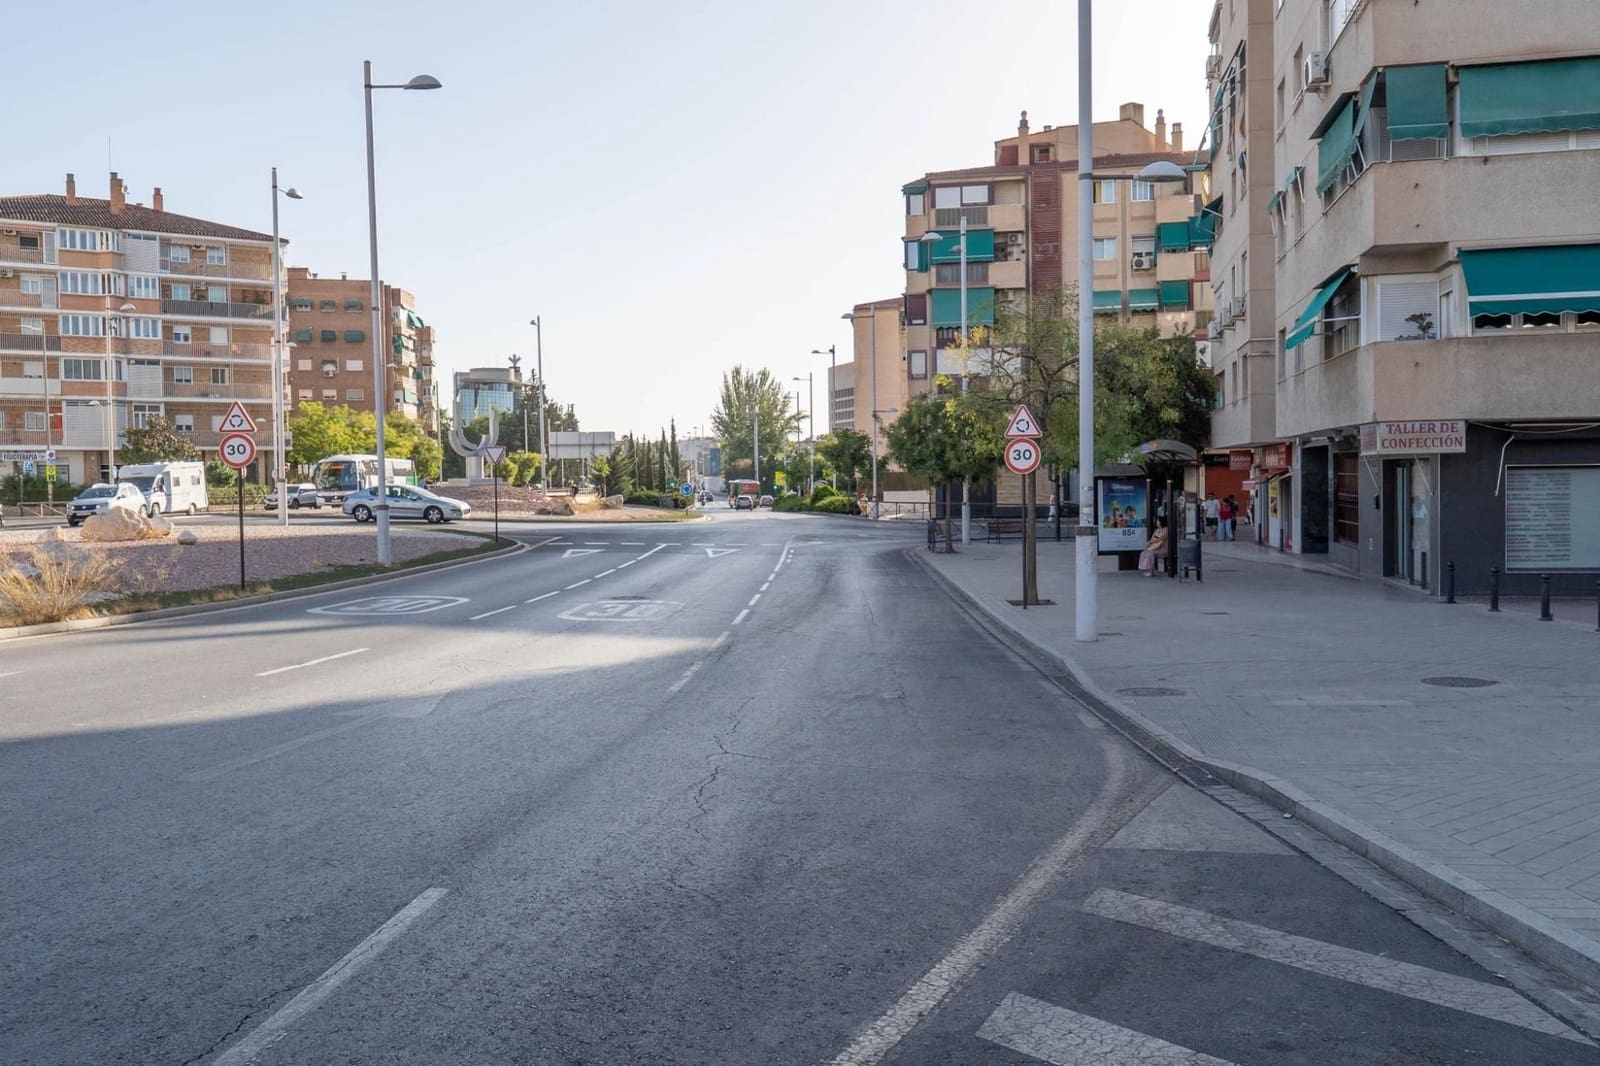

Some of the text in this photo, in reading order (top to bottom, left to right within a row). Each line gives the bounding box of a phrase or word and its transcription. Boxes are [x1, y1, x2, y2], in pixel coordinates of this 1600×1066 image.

[1385, 422, 1459, 435] TALLER DE
[1381, 435, 1464, 449] CONFECCIÓN
[3, 452, 38, 460] FISIOTERAPIA
[226, 443, 247, 456] 30
[1012, 449, 1032, 461] 30
